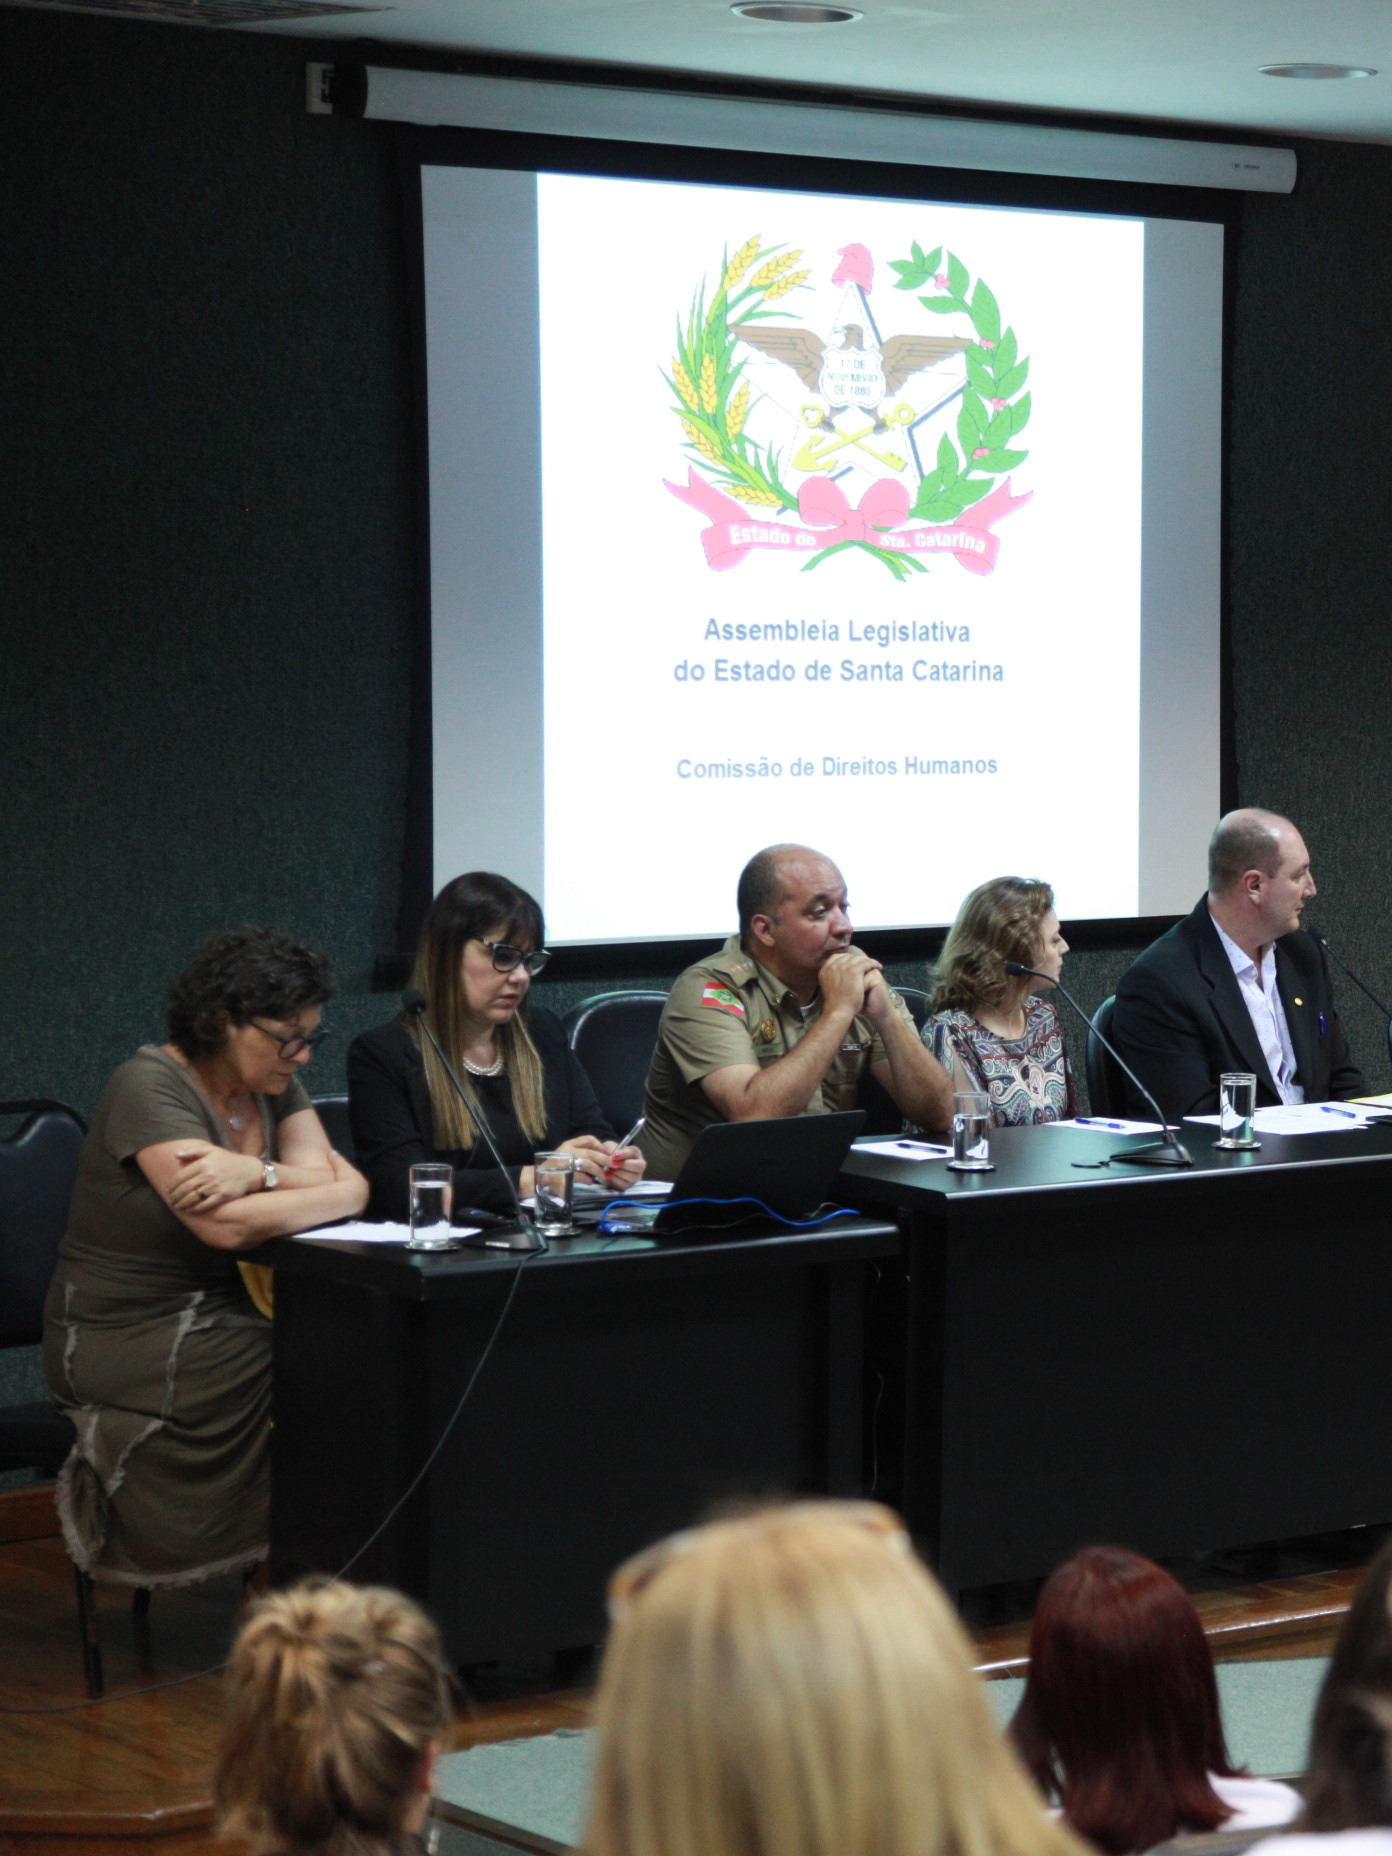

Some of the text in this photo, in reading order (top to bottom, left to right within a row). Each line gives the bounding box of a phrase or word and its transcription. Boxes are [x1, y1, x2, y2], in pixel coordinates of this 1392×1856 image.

[853, 359, 866, 370] DE
[834, 384, 846, 396] DE
[729, 524, 986, 555] Estado de Sta. Catarina
[704, 618, 971, 648] Assembleia Legislativa
[673, 658, 1004, 682] do Estado de Santa Catarina
[676, 755, 998, 779] Comissão de Direitos Humanos
